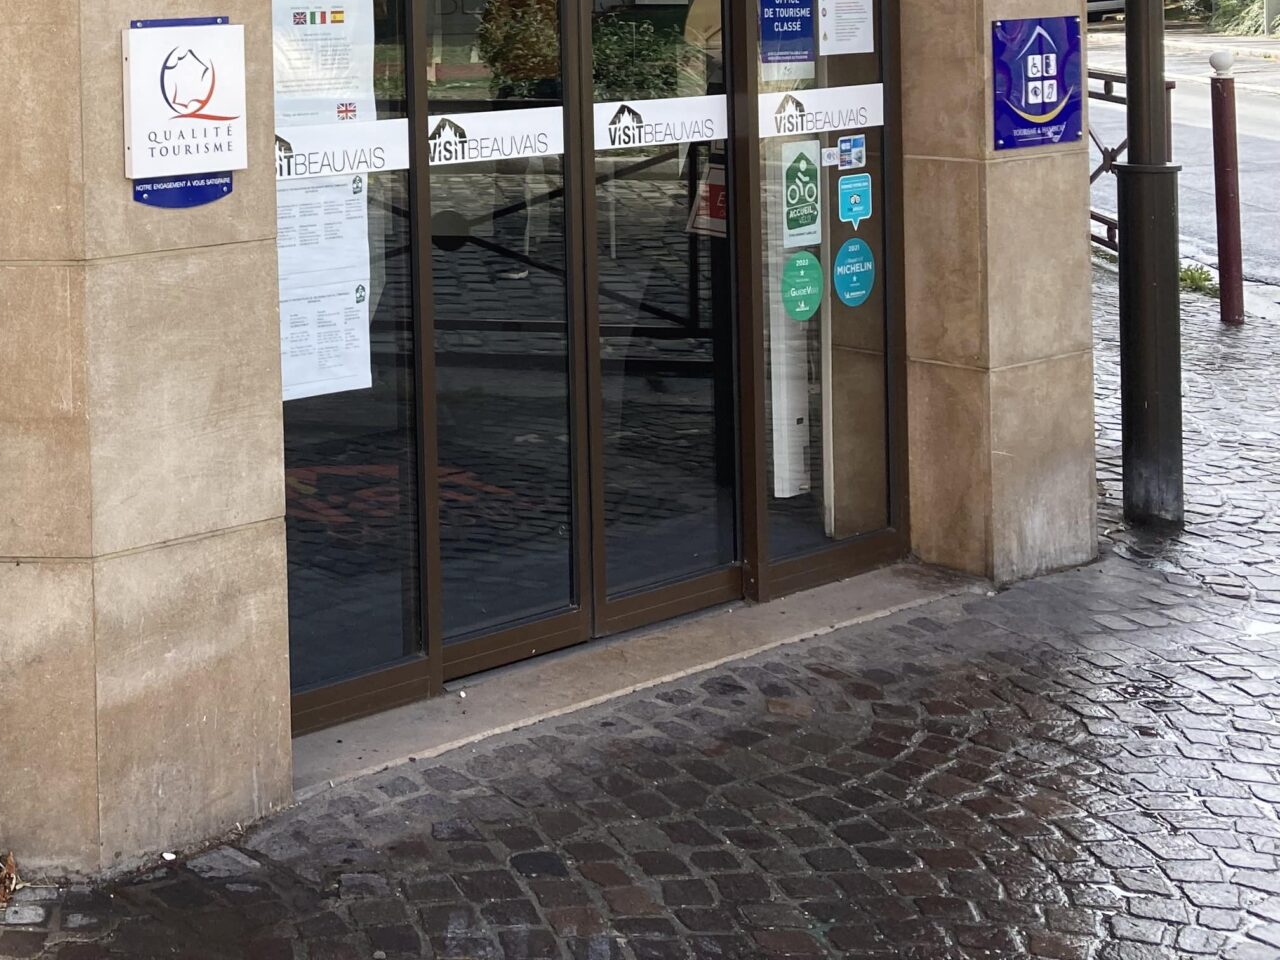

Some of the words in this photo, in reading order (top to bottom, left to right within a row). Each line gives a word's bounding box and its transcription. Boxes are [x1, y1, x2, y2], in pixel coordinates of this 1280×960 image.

[764, 8, 774, 18] DE
[775, 7, 811, 17] TOURISME
[774, 19, 802, 32] CLASSÉ
[148, 123, 233, 144] QUALITÉ
[149, 141, 233, 158] TOURISME
[153, 181, 186, 190] ENGAGEMENT
[206, 177, 231, 185] SATISFAIRE
[789, 207, 814, 219] ACCUEIL
[836, 261, 872, 276] MICHELIN
